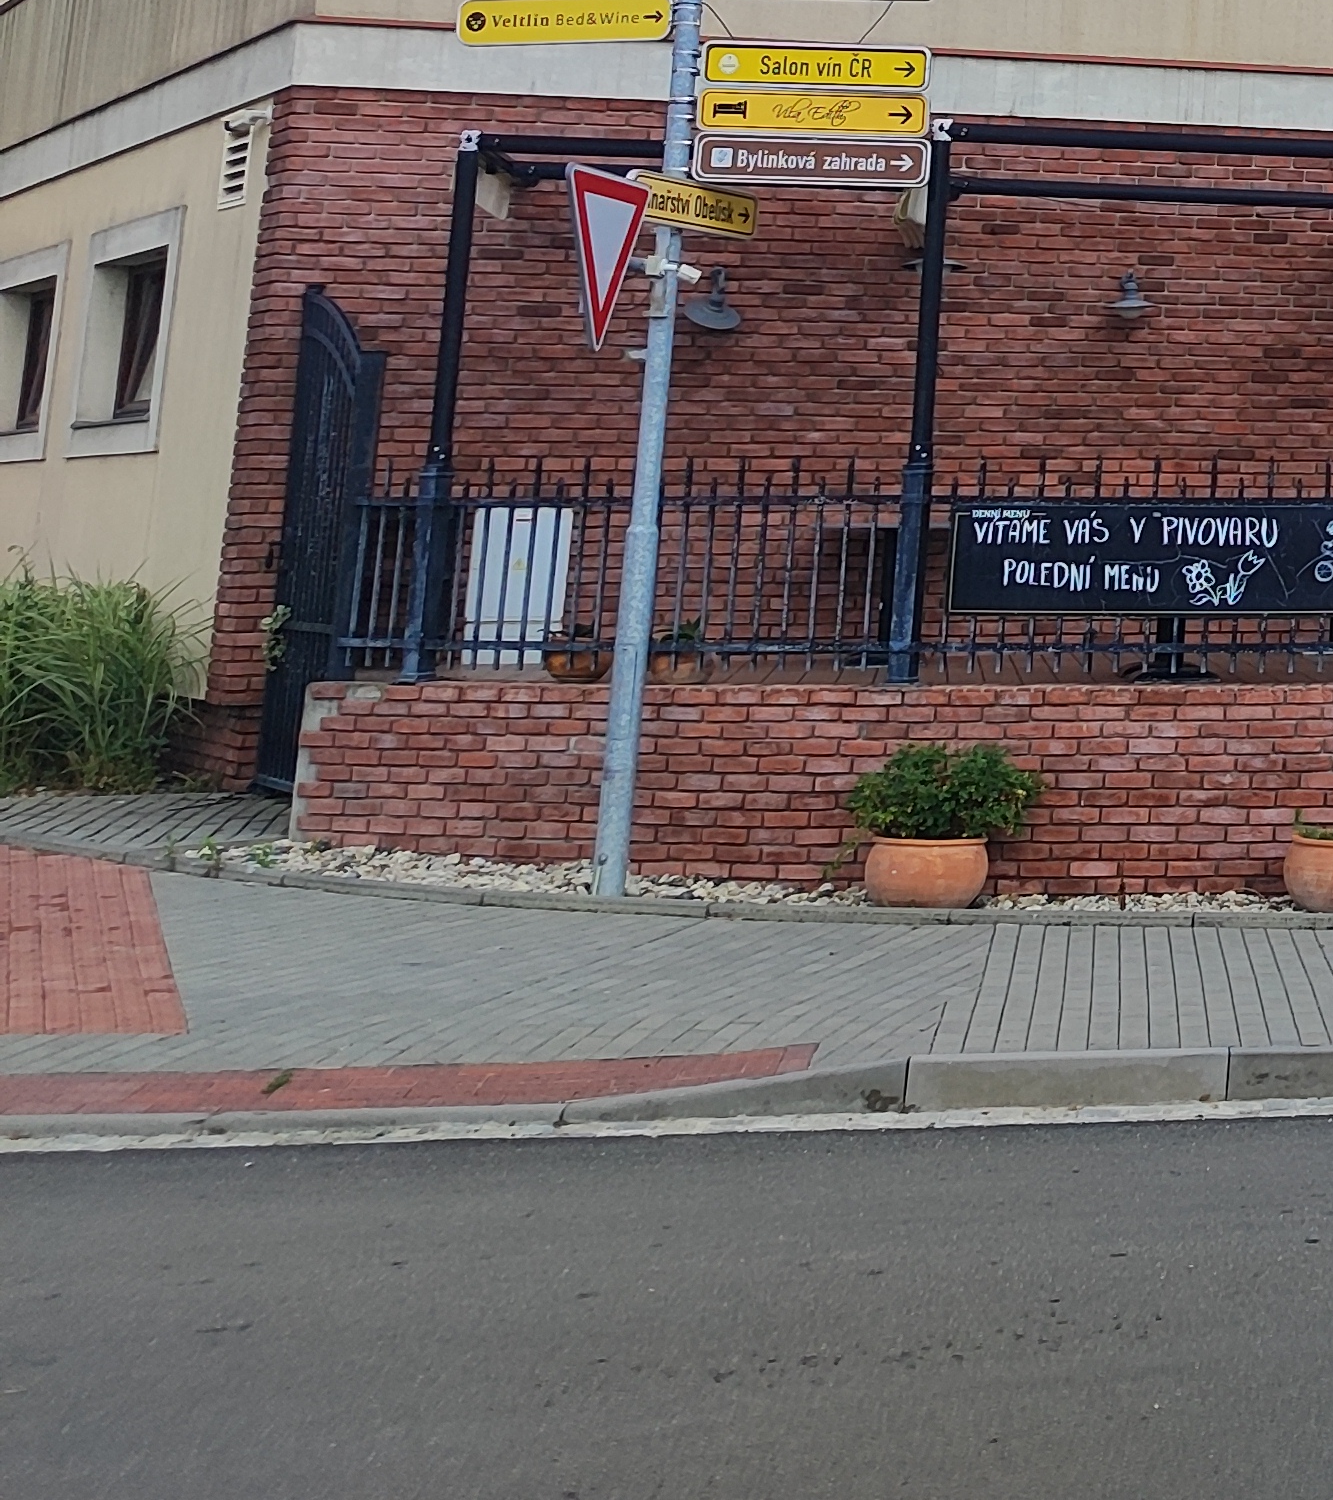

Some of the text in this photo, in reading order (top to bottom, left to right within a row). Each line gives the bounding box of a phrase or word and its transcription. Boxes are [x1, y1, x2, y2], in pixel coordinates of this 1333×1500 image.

[491, 10, 641, 29] Veltlin Bed&Wine
[759, 52, 872, 79] Salon vín ČR
[736, 148, 887, 173] Bylinková zahrada
[646, 185, 693, 216] inařství
[1063, 510, 1110, 544] VÁS
[1129, 516, 1147, 544] V
[1161, 516, 1279, 548] PIVOVARU
[1003, 555, 1096, 592] POLEDNÍ
